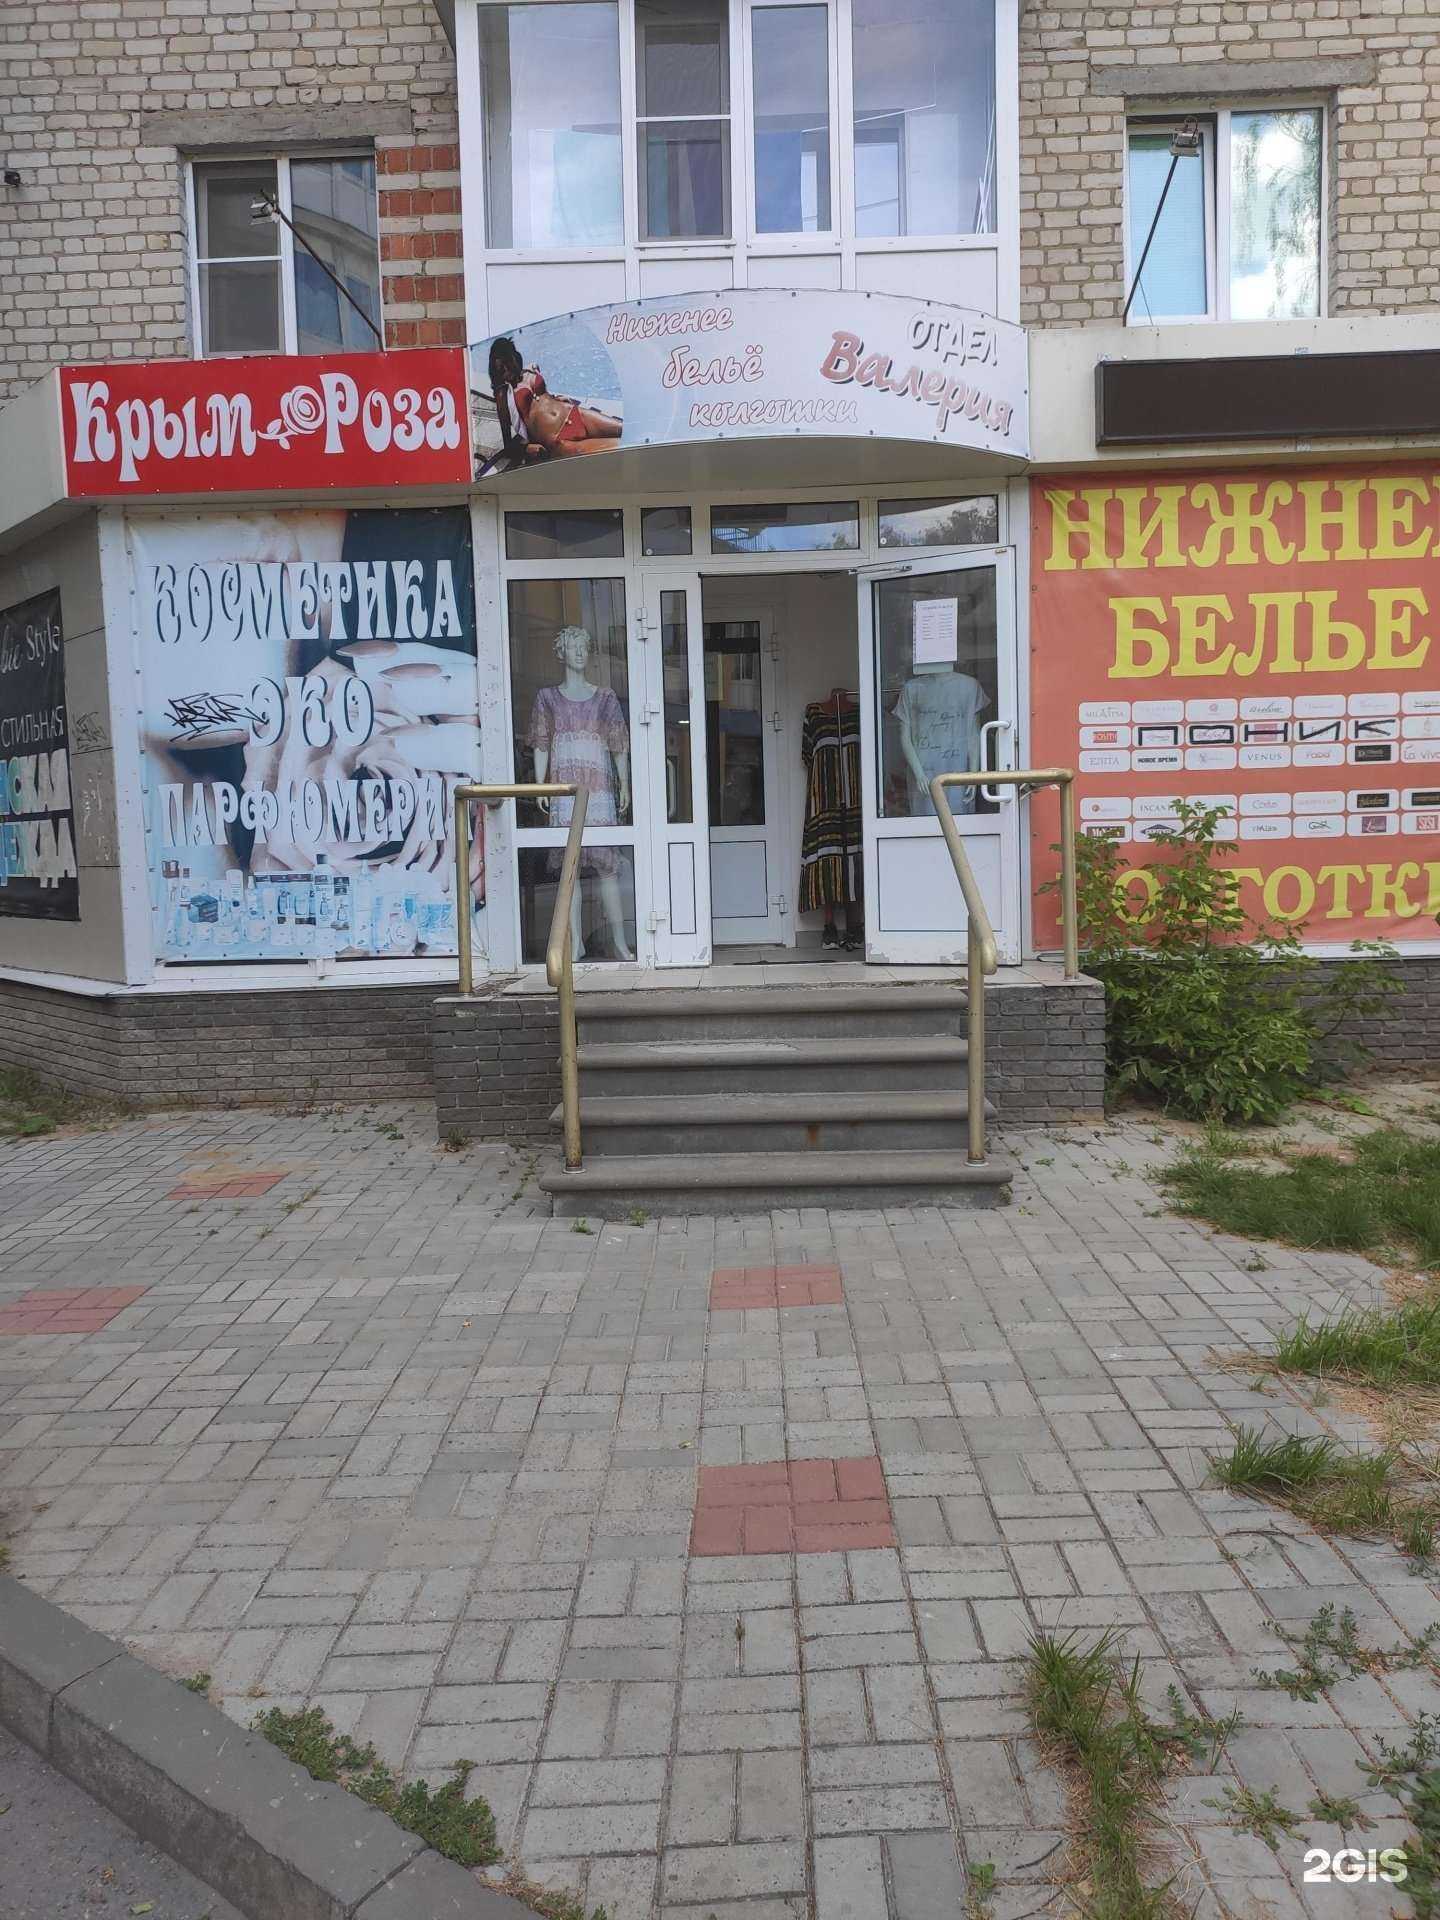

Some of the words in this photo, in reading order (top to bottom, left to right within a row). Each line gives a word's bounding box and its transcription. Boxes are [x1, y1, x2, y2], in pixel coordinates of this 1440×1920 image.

[606, 306, 735, 344] Нижнее
[907, 312, 998, 366] ОТДЕЛ
[662, 344, 764, 389] бельё
[819, 330, 1013, 436] Валерия
[69, 380, 256, 482] Крым
[319, 371, 461, 454] Роза
[688, 398, 859, 428] колготки
[1044, 476, 1440, 571] НИЖНЕ
[147, 559, 464, 644] КОСМЕТИКА
[25, 615, 60, 667] Style
[1108, 587, 1432, 679] БЕЛЬЕ
[1, 705, 64, 748] СТИЛЬНАЯ
[248, 675, 374, 748] ЭКО
[1247, 751, 1283, 761] VENUS
[1055, 861, 1440, 927] ОГОТК
